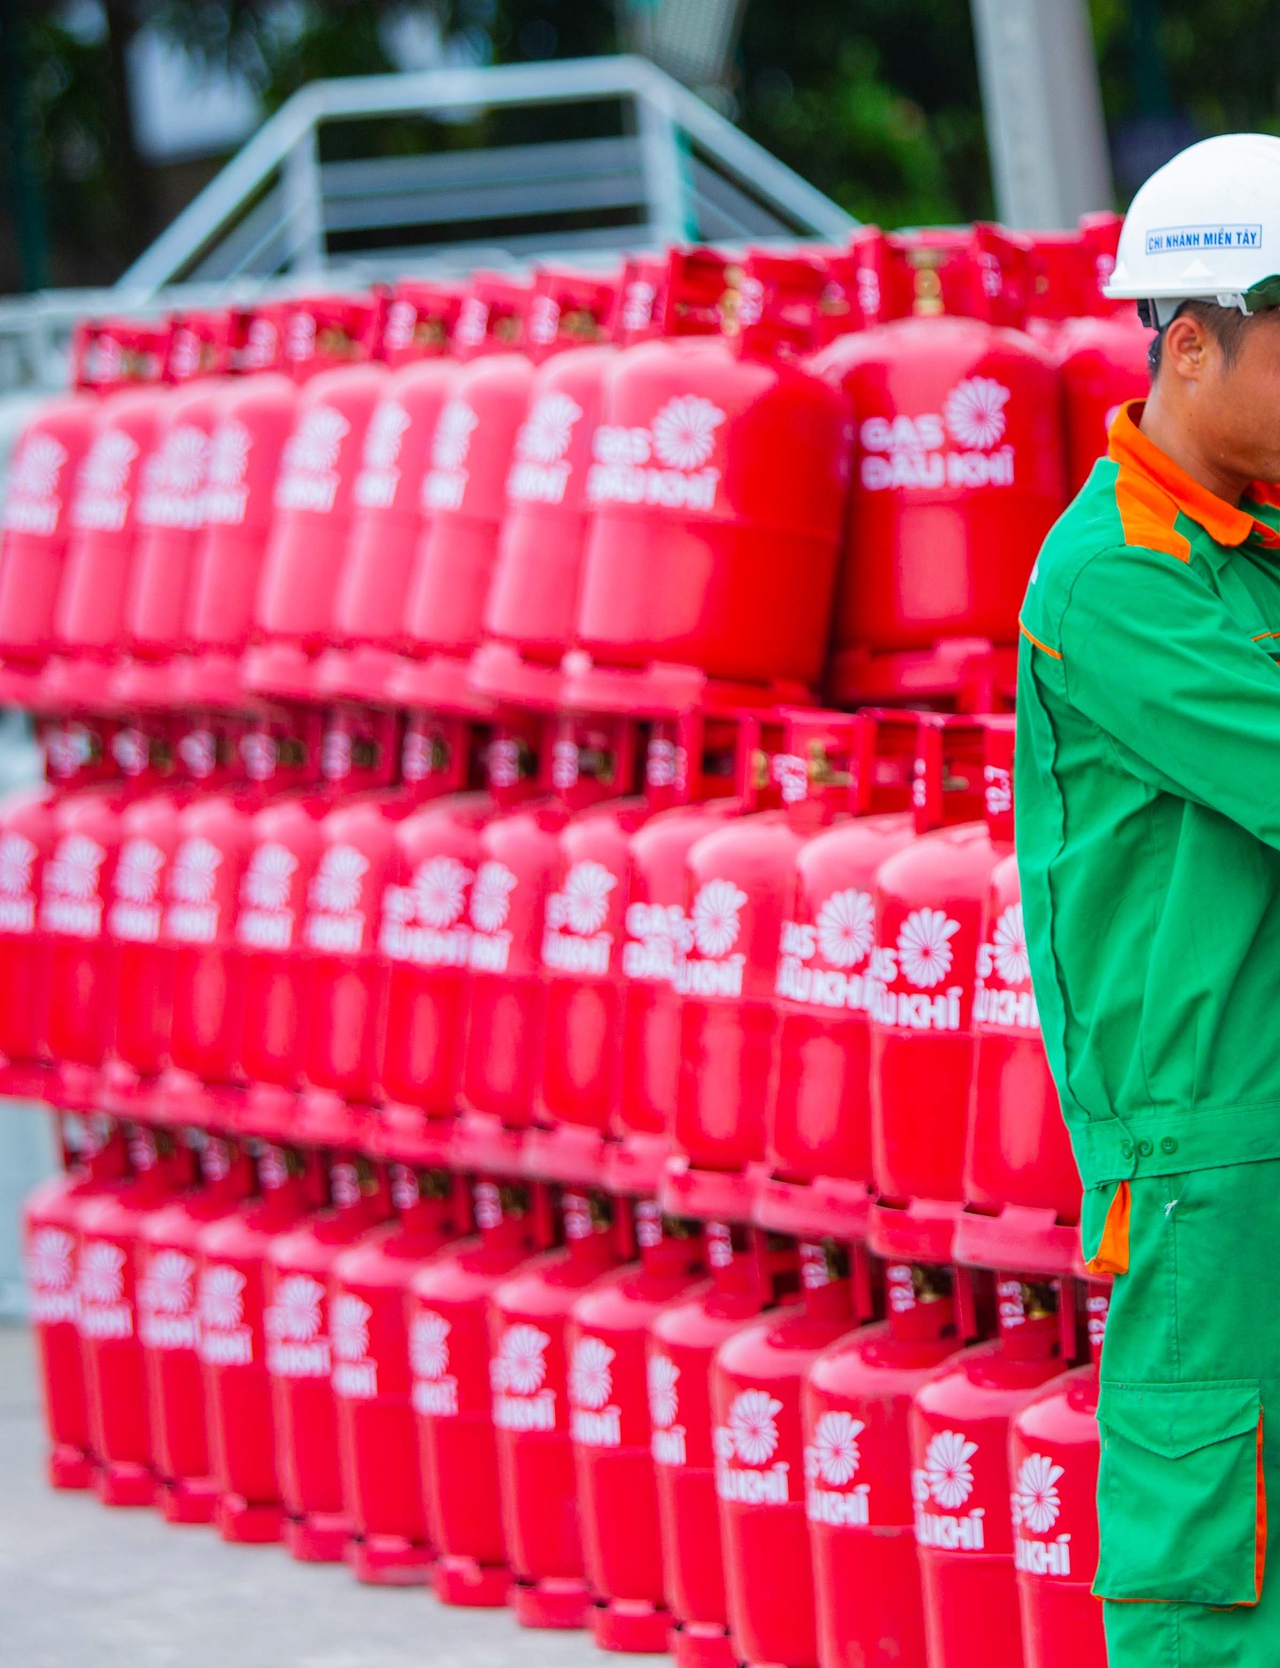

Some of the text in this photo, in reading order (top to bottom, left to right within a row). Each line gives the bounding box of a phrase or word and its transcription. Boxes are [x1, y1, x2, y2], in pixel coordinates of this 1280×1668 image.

[1148, 226, 1258, 250] CHI NHÁNH MIỀN TÂY
[860, 413, 946, 452] GAS
[897, 985, 963, 1031] KHÍ
[932, 1507, 986, 1551] KHÍ
